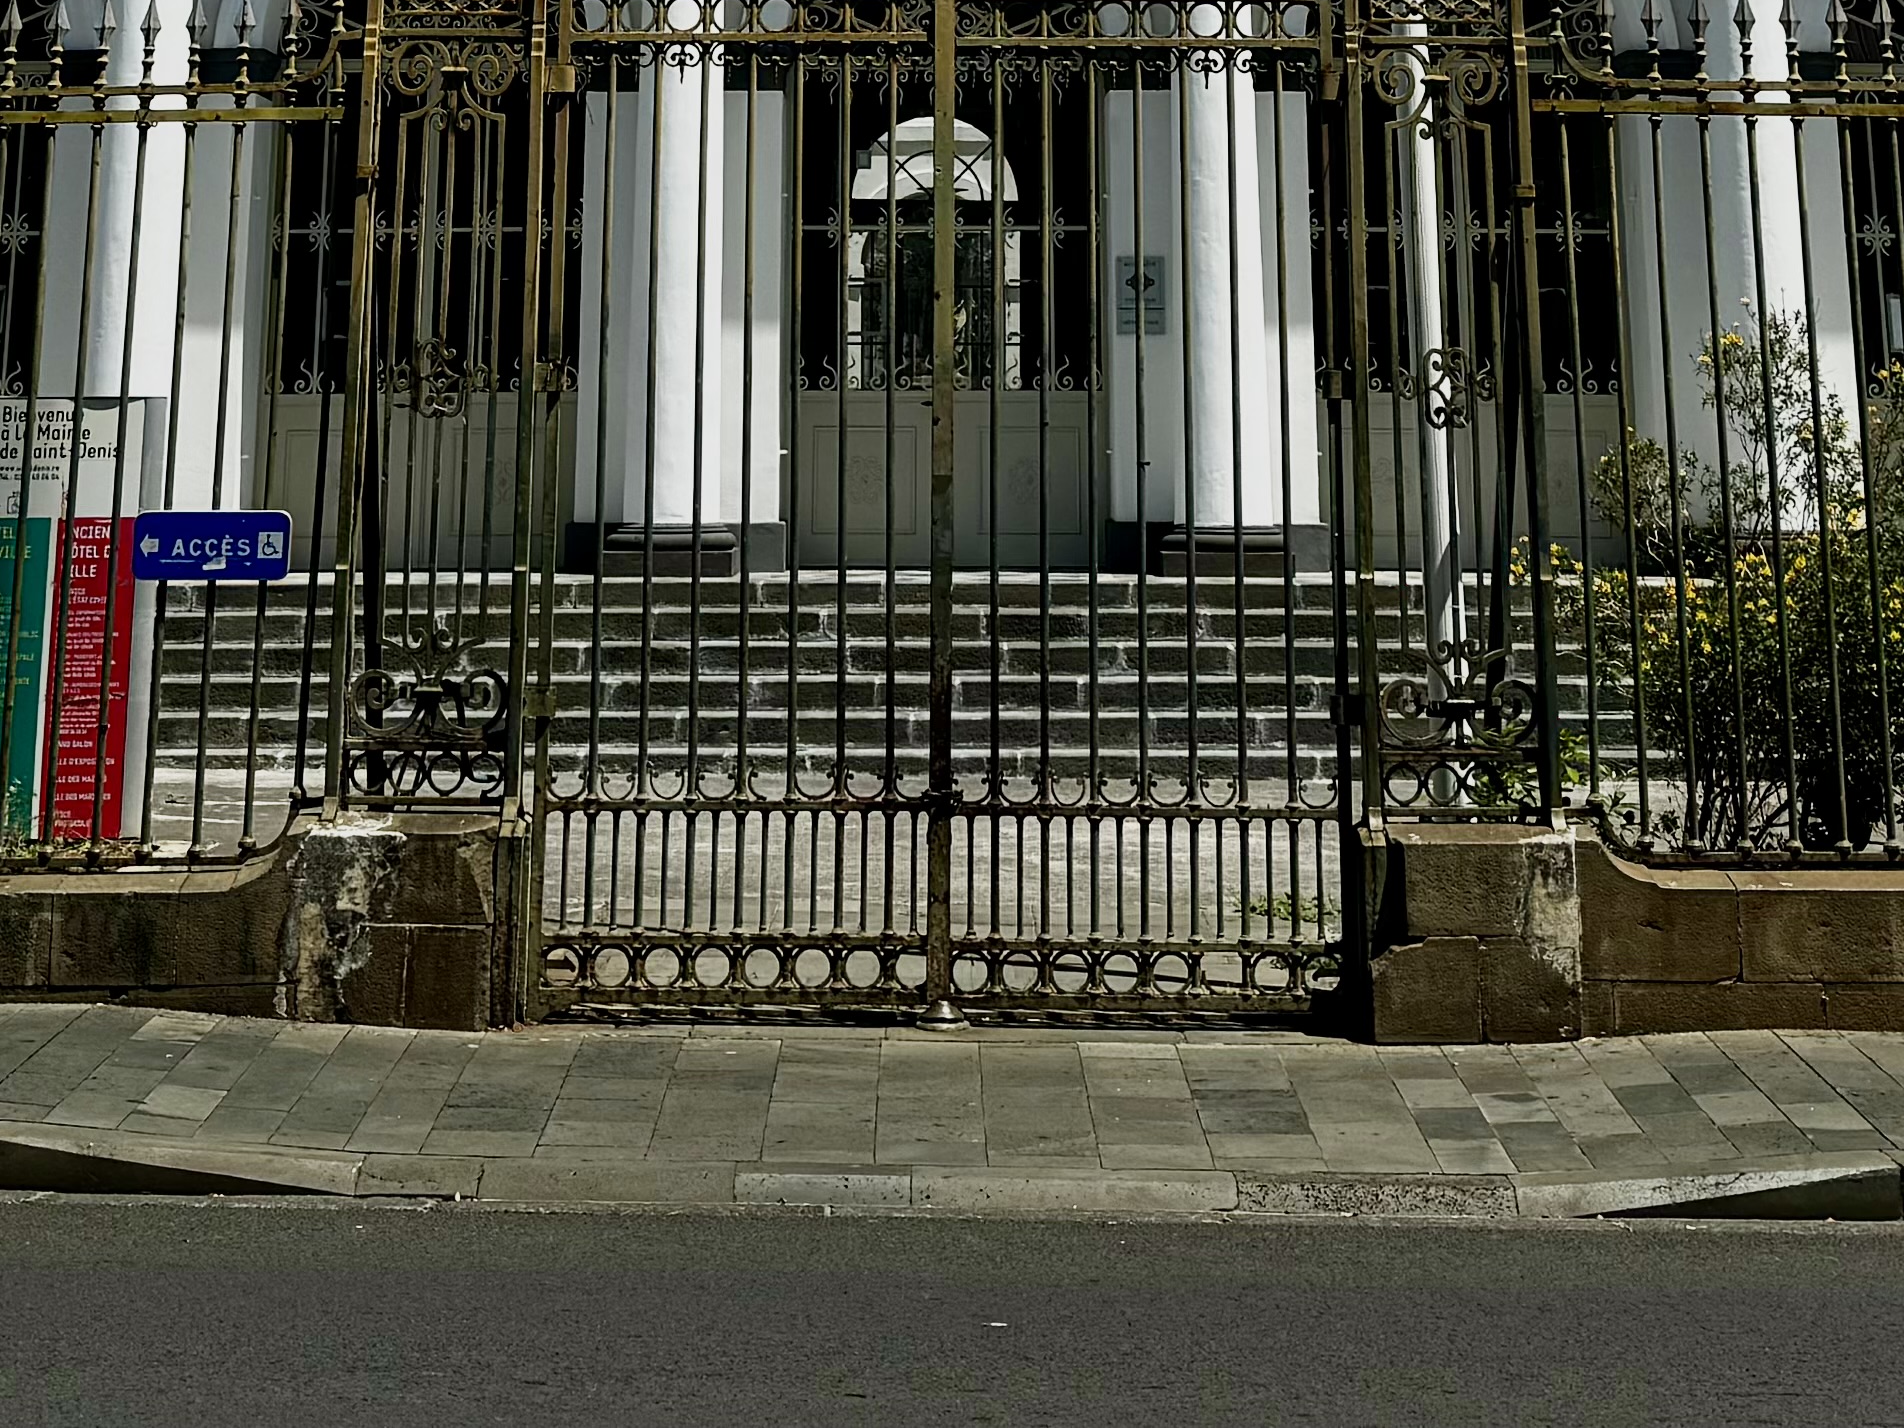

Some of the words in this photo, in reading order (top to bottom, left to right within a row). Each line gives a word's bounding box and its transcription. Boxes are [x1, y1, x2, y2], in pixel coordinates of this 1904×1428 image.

[2, 405, 84, 423] Bievenu
[1, 423, 9, 441] à
[37, 424, 91, 441] Maire
[0, 442, 18, 459] de
[28, 441, 120, 460] aint-Denis
[65, 525, 111, 540] NCIEN
[65, 541, 100, 559] ÔTEL
[171, 534, 251, 557] ACCÈS
[66, 564, 97, 579] ILLE
